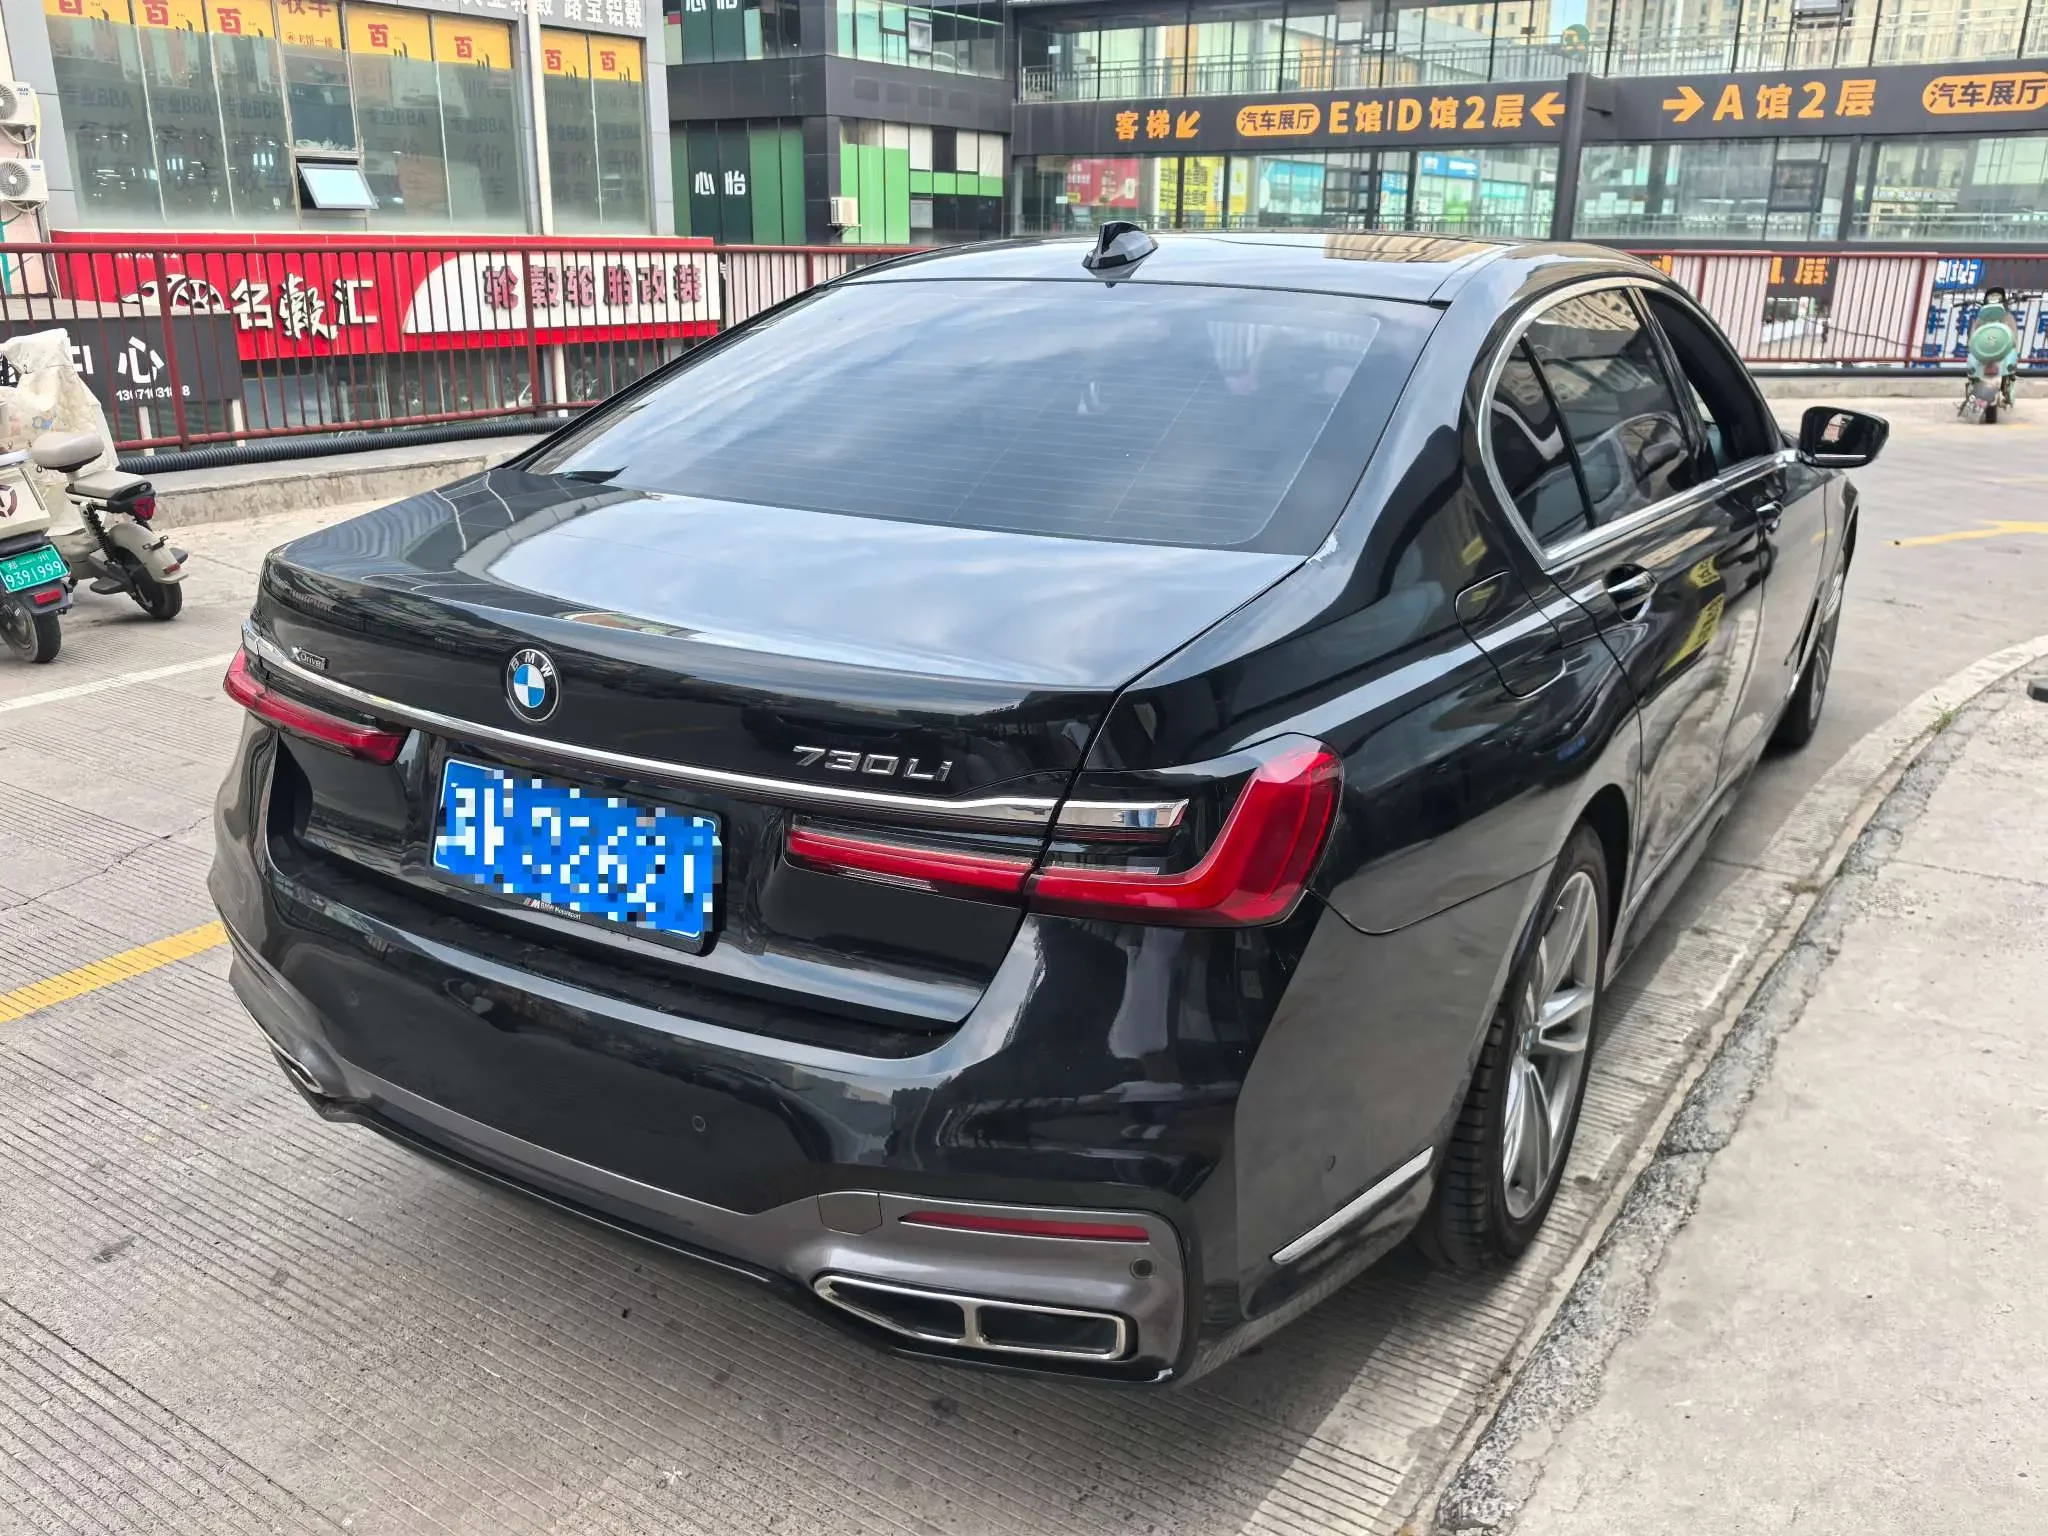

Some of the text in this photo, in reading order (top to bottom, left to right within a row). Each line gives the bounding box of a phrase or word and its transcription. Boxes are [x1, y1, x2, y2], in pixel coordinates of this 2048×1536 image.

[1929, 78, 2048, 108] 汽车展厅
[1115, 109, 1171, 140] 客梯
[1240, 108, 1315, 131] 汽车展厅
[694, 170, 746, 195] 心怡
[5, 561, 61, 587] 9391999
[510, 651, 554, 678] BMW
